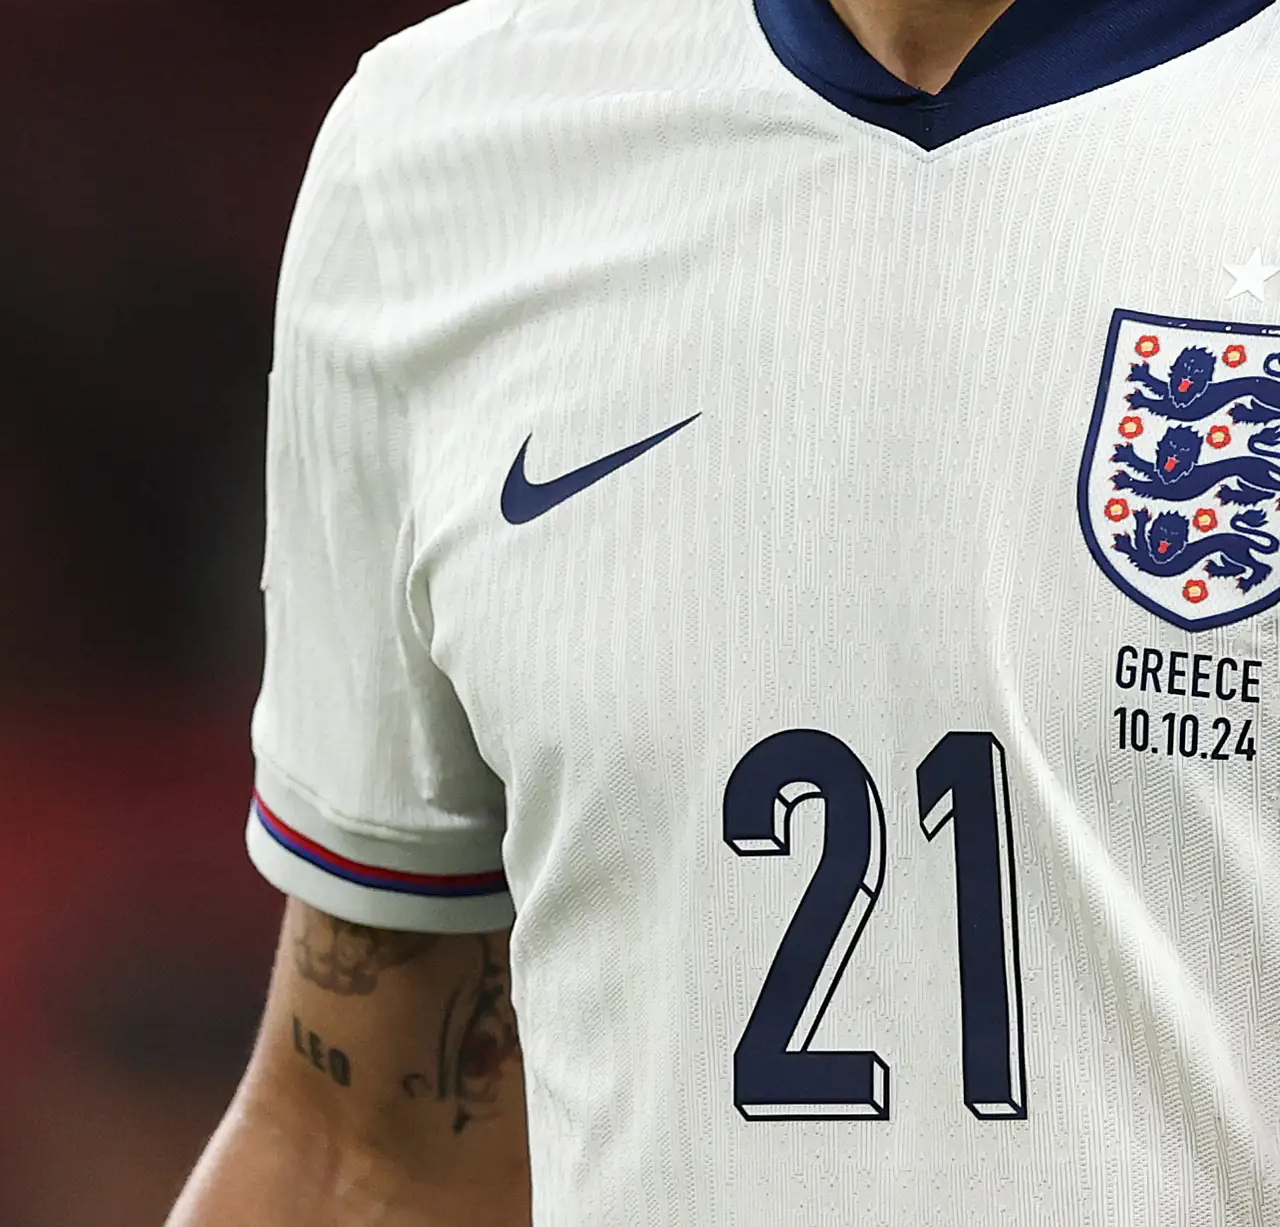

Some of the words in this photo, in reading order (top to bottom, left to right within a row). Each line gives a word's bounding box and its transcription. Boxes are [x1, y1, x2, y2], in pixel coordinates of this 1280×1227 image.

[1115, 644, 1263, 704] GREECE
[1113, 706, 1257, 762] 10.10.24
[722, 727, 1028, 1122] 21
